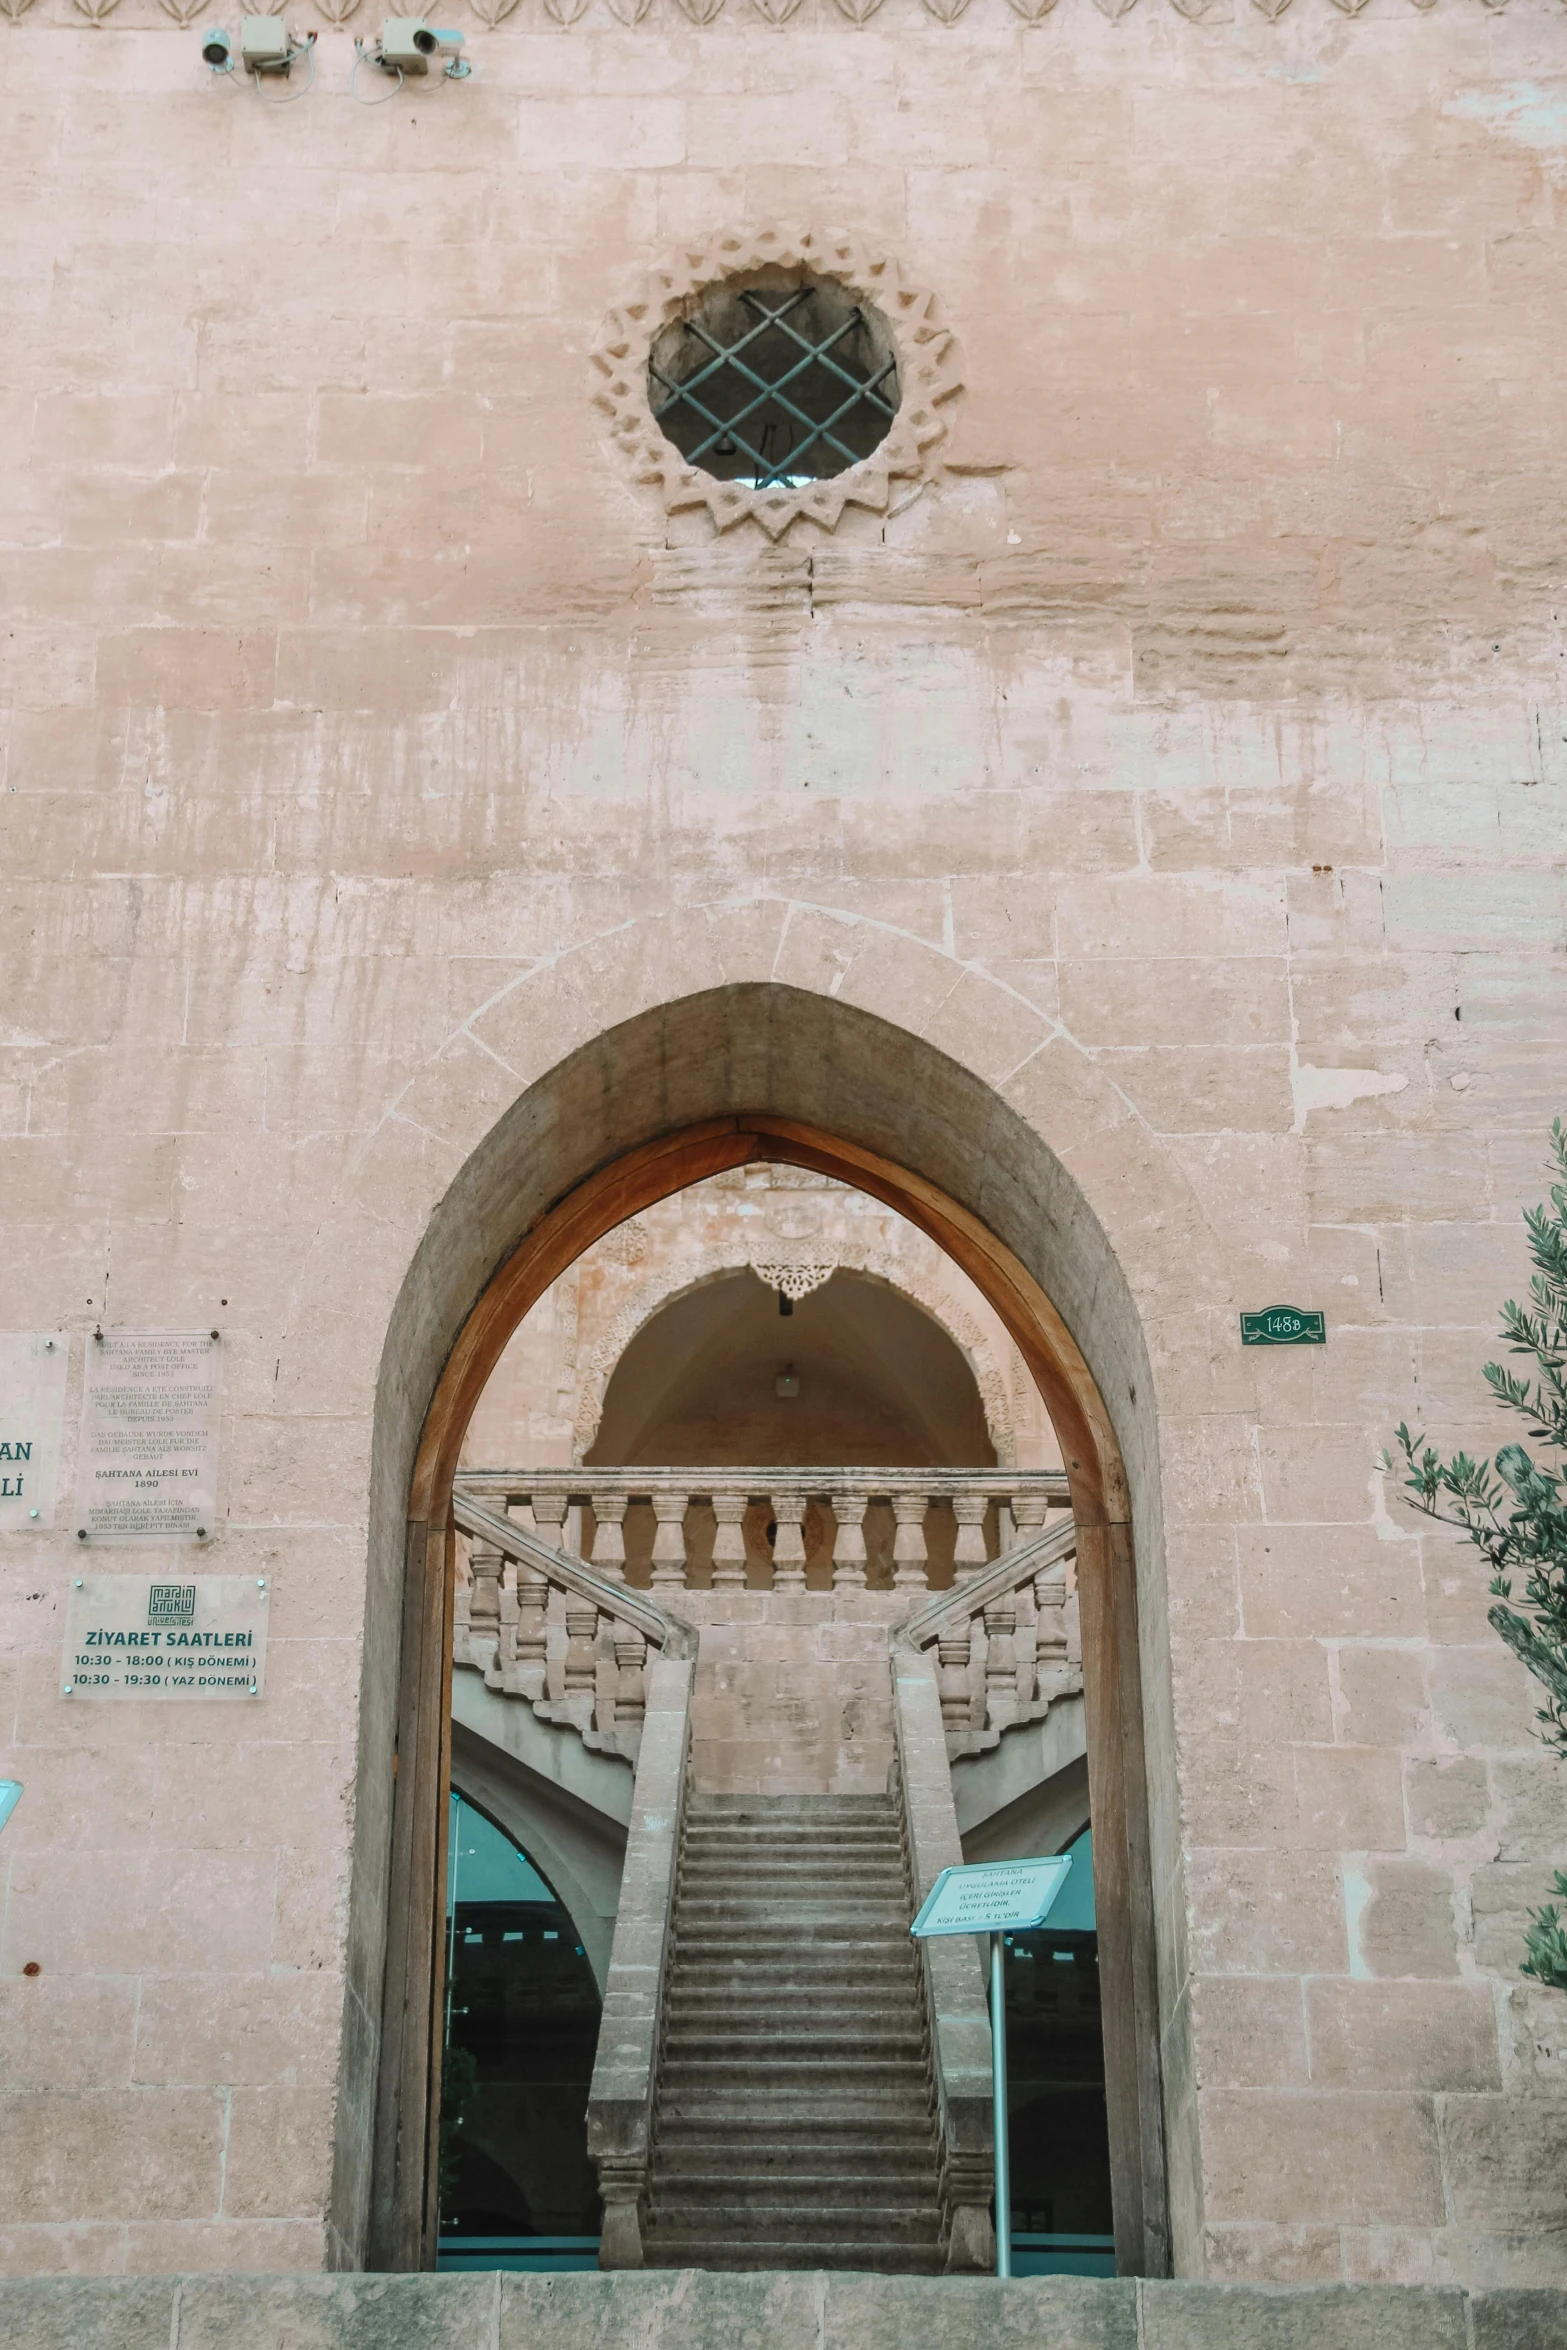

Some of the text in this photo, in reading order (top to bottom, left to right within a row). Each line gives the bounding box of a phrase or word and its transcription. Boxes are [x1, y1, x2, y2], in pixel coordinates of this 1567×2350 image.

[1267, 1316, 1301, 1332] 148B
[96, 1468, 198, 1479] ŞAHTANA AİLESİ EVİ
[107, 1500, 141, 1508] ŞAHTANA
[85, 1629, 253, 1647] ZİYARET SAATLERİ
[75, 1655, 112, 1666] 10:30
[127, 1655, 164, 1666] 18:00
[175, 1658, 195, 1668] KIŞ
[198, 1655, 249, 1667] DÖNEMİ
[73, 1674, 110, 1685] 10:30
[124, 1674, 161, 1685] 19:30
[172, 1676, 195, 1686] YAZ
[199, 1674, 250, 1686] DÖNEMİ
[1010, 1877, 1036, 1886] OTELİ
[960, 1889, 1022, 1901] İÇERİ GİRİŞLER
[936, 1916, 953, 1924] KİŞİ
